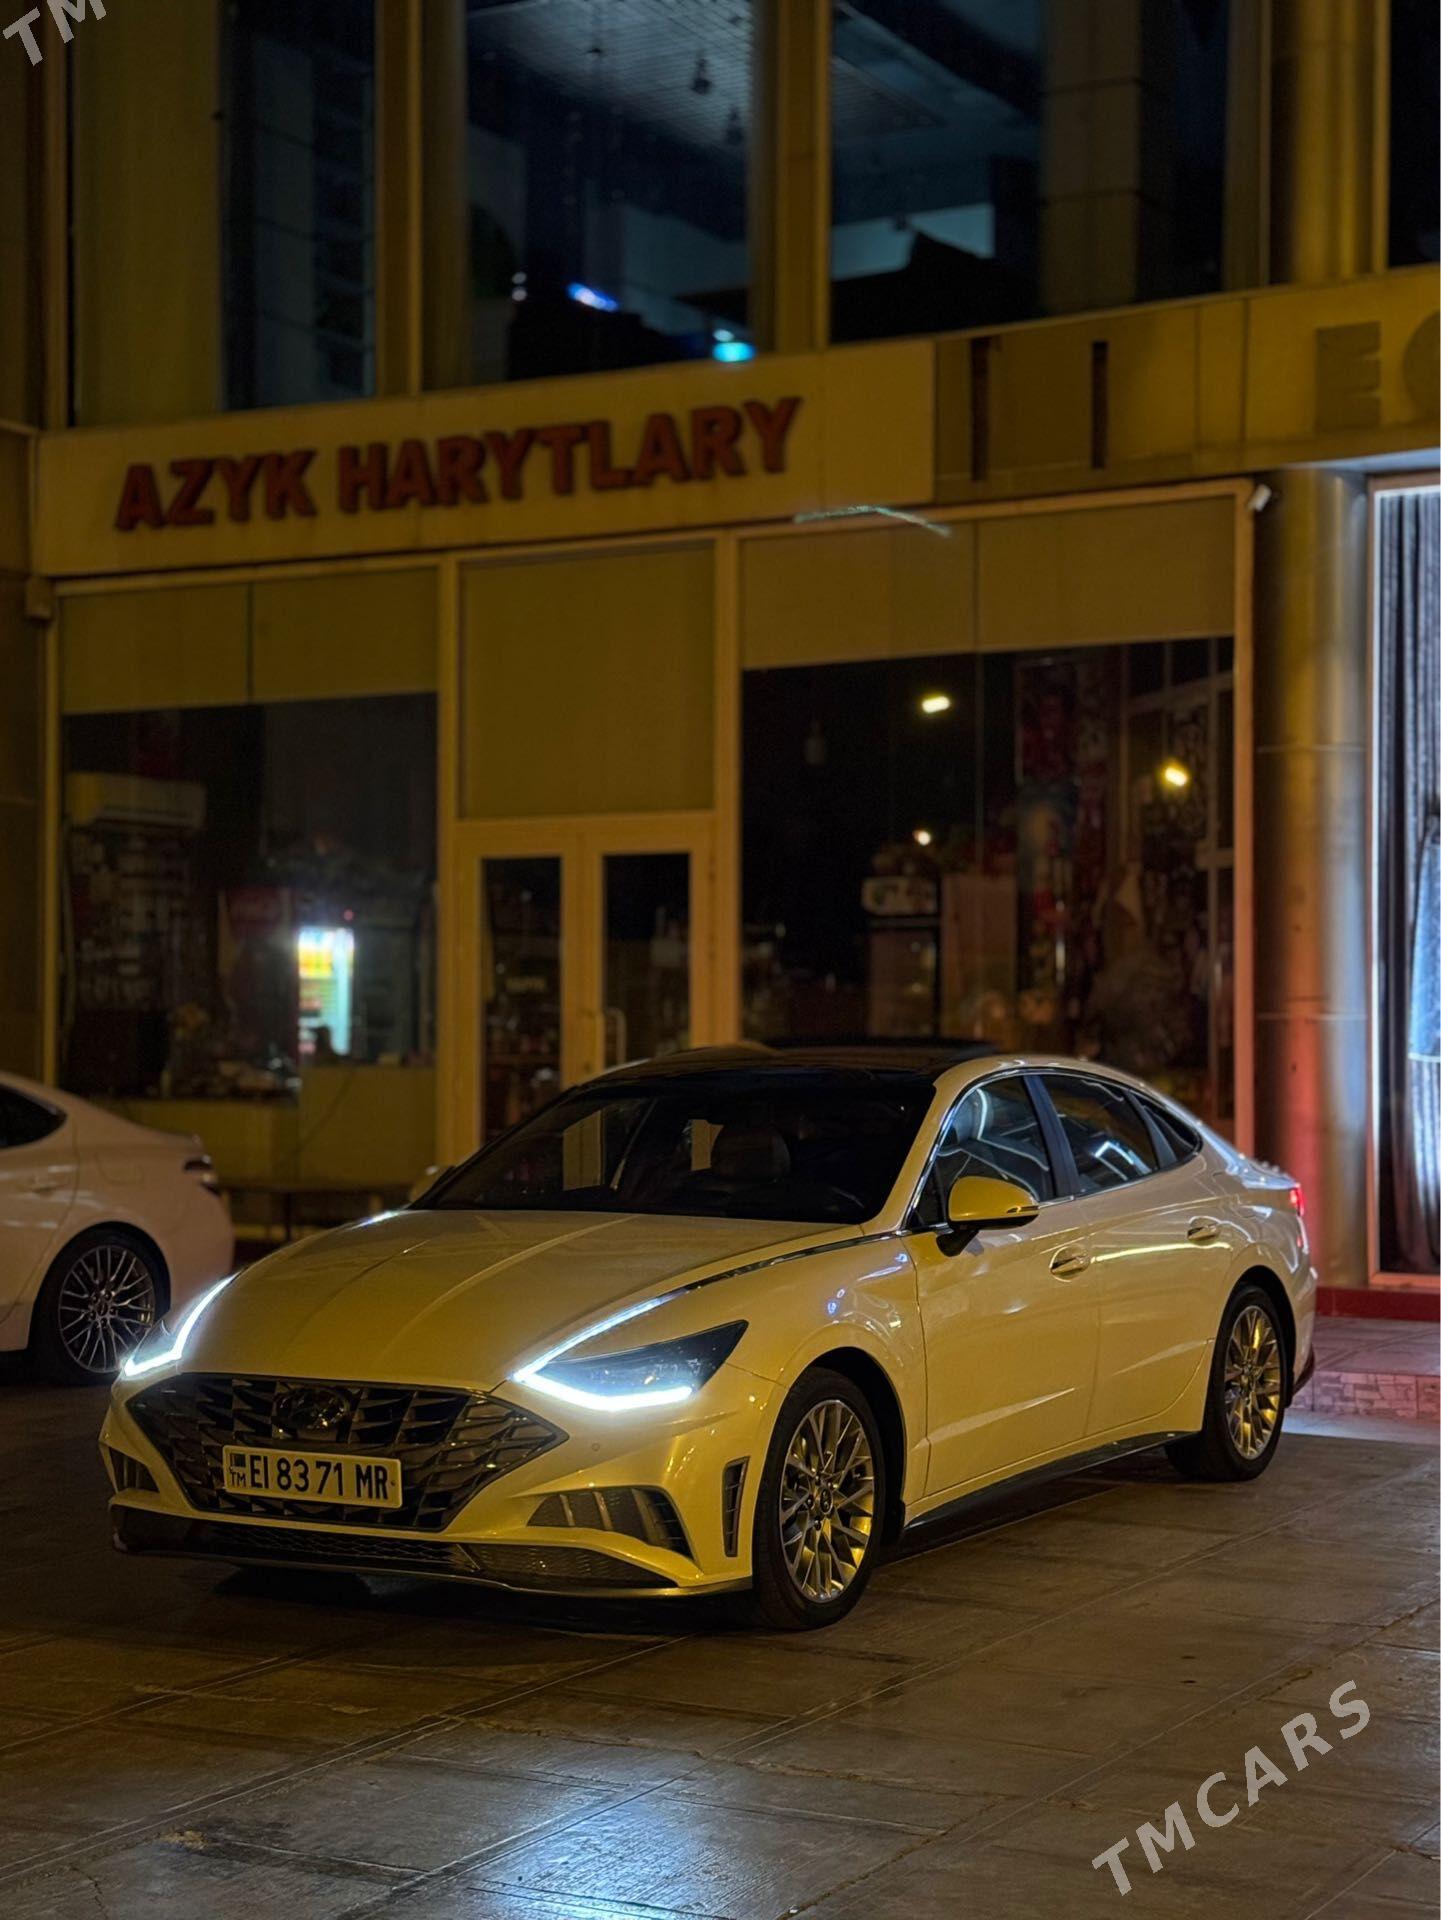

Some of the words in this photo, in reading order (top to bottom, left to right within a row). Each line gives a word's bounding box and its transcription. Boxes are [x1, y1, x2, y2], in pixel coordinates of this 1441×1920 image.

[114, 449, 317, 531] AZYK
[337, 396, 803, 513] HARYTLARY
[230, 1471, 246, 1487] TM
[250, 1455, 269, 1489] EI
[355, 1463, 389, 1500] MR
